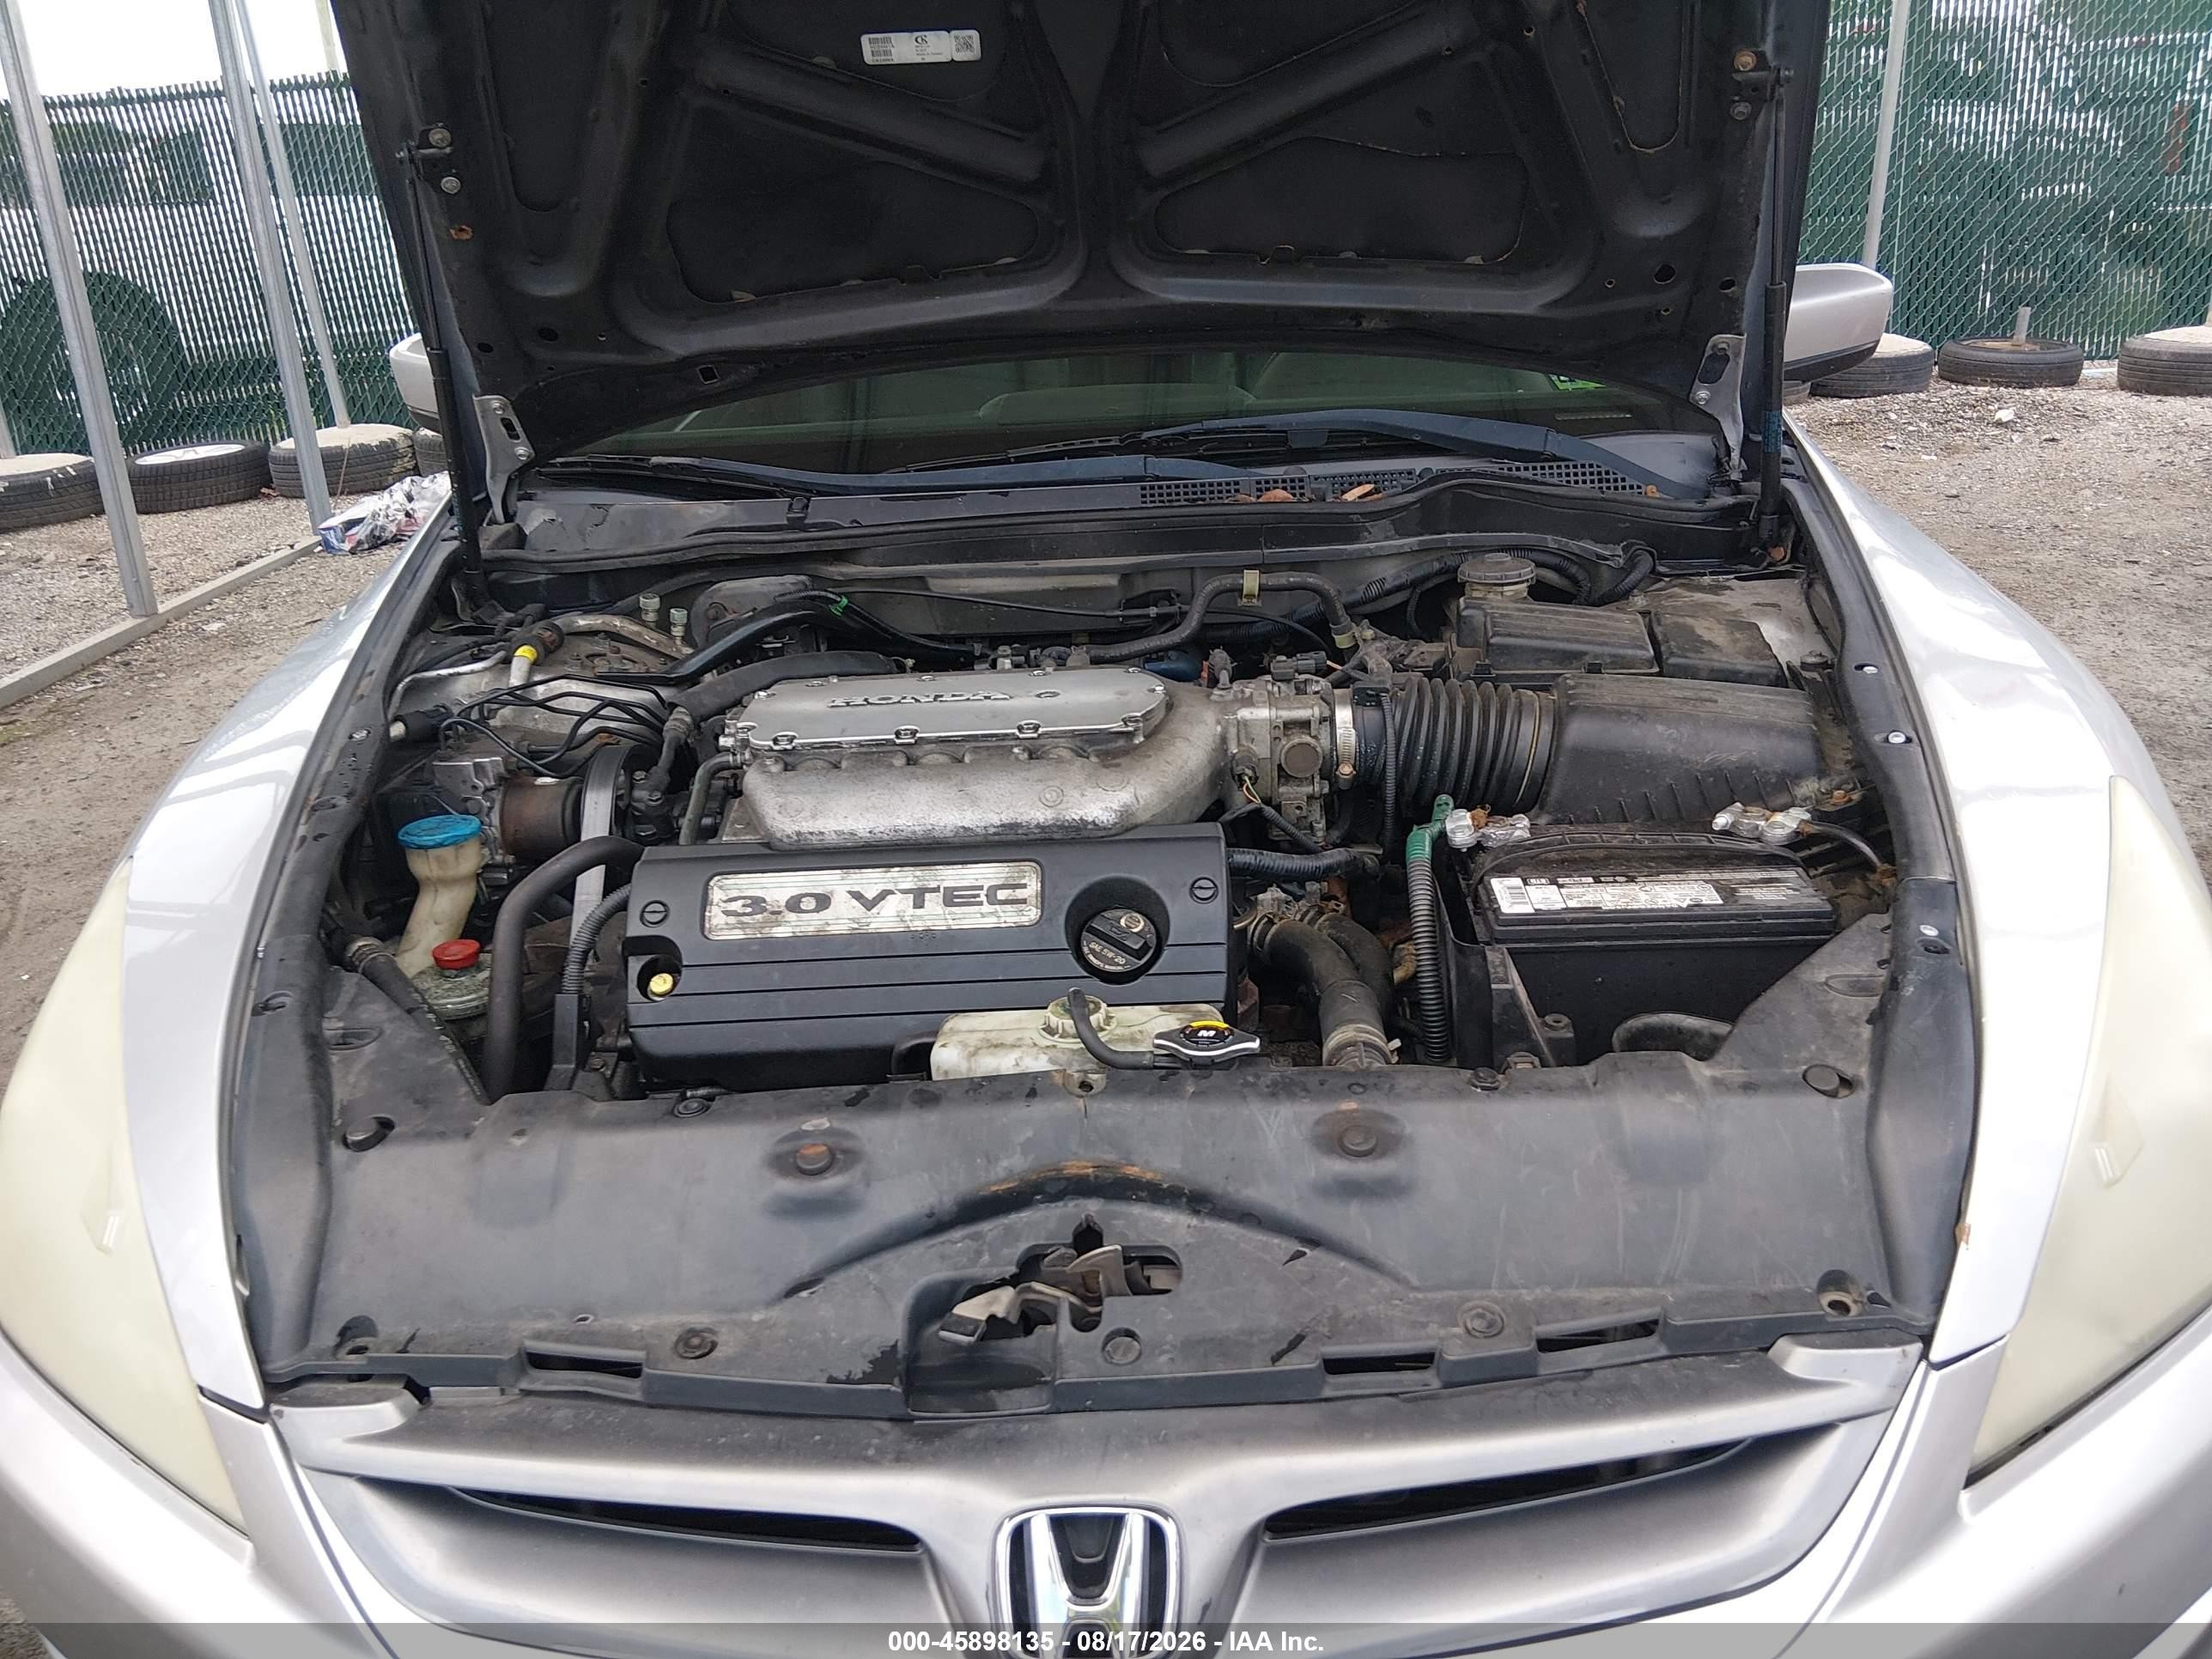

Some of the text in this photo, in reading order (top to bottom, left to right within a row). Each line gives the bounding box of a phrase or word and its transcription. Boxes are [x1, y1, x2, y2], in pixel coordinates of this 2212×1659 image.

[828, 690, 1012, 708] HONDA
[720, 883, 1028, 917] 3.0 VTEC
